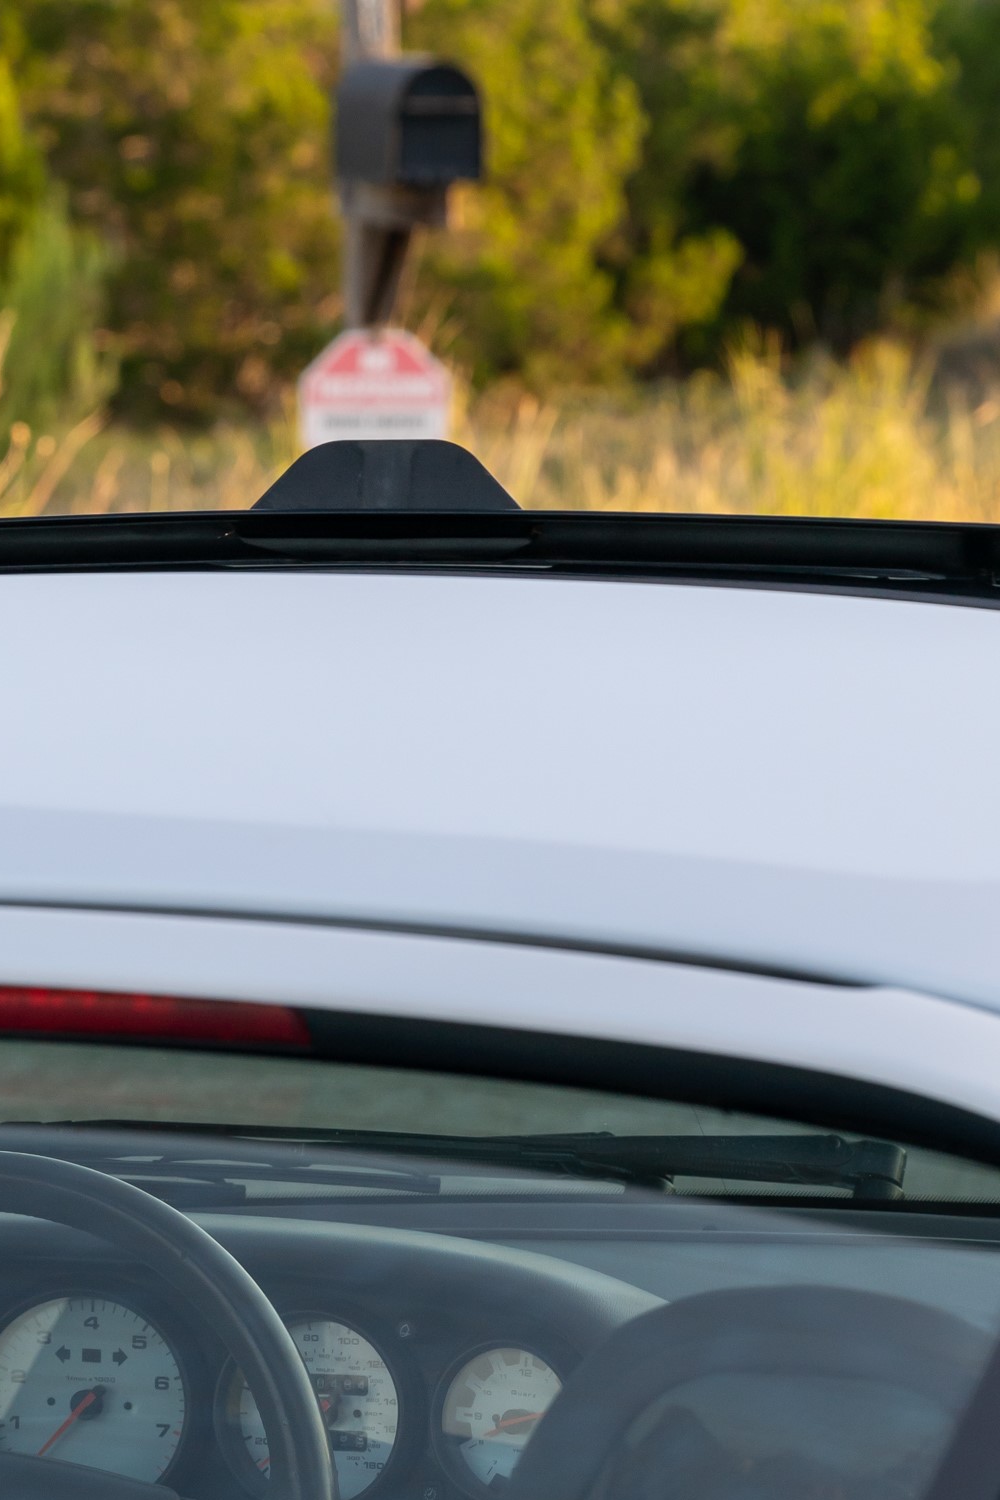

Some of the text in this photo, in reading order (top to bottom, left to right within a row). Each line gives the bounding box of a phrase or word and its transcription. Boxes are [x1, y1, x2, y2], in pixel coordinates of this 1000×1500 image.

[84, 1316, 100, 1330] 4
[37, 1332, 52, 1345] 3
[132, 1336, 148, 1350] 5
[303, 1334, 320, 1342] 80
[338, 1337, 360, 1345] 100
[11, 1370, 26, 1384] 2
[518, 1368, 532, 1378] 12
[154, 1376, 170, 1390] 6
[10, 1416, 20, 1429] 1
[474, 1412, 482, 1420] 9
[156, 1424, 170, 1438] 7
